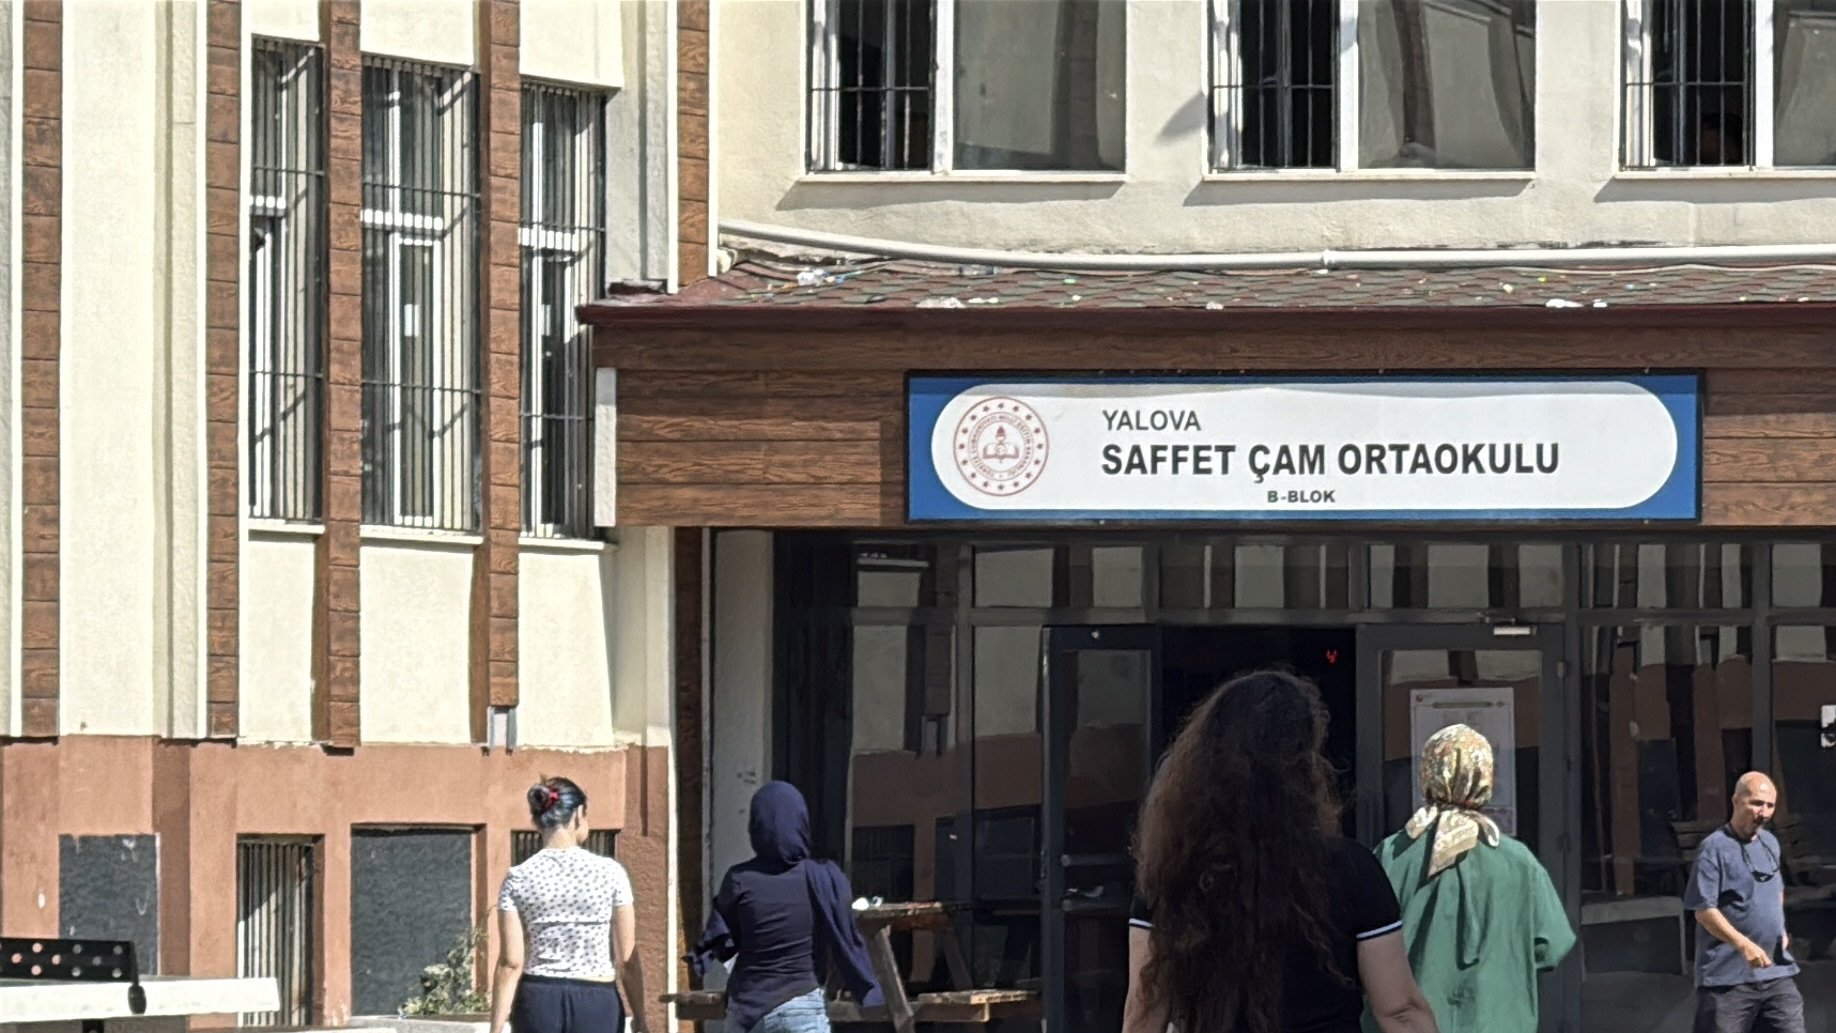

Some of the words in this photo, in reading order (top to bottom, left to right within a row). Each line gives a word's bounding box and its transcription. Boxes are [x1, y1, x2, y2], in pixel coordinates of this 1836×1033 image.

[1102, 410, 1201, 431] YALOVA
[1102, 444, 1236, 475] SAFFET
[1248, 444, 1325, 483] ÇAM
[1338, 443, 1559, 475] ORTAOKULU
[1267, 490, 1335, 503] B-BLOK
